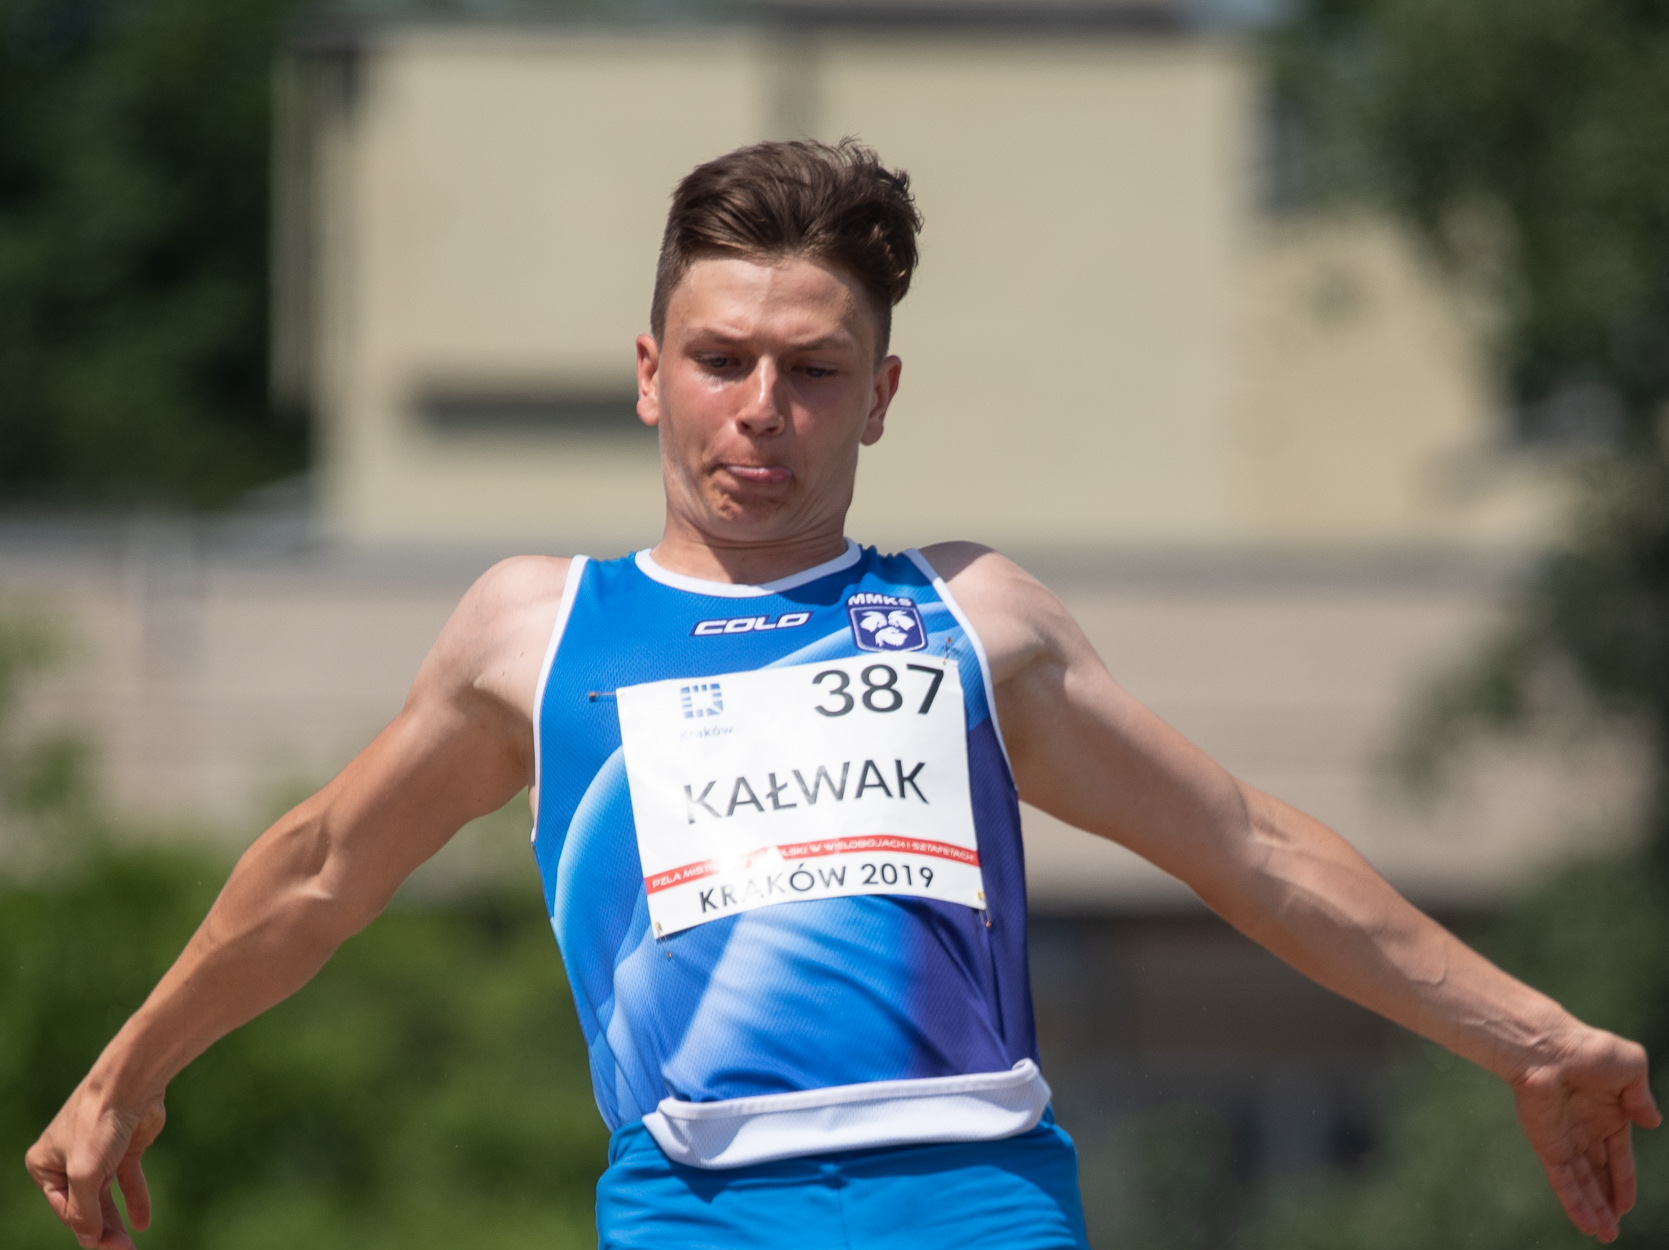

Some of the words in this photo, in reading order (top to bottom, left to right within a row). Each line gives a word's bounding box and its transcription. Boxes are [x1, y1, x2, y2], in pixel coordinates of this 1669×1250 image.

[693, 612, 811, 636] COLO
[848, 593, 912, 607] MMKS
[811, 663, 945, 718] 387
[683, 758, 930, 825] KAŁWAK
[699, 862, 847, 914] KRAKÓW
[860, 862, 934, 888] 2019
